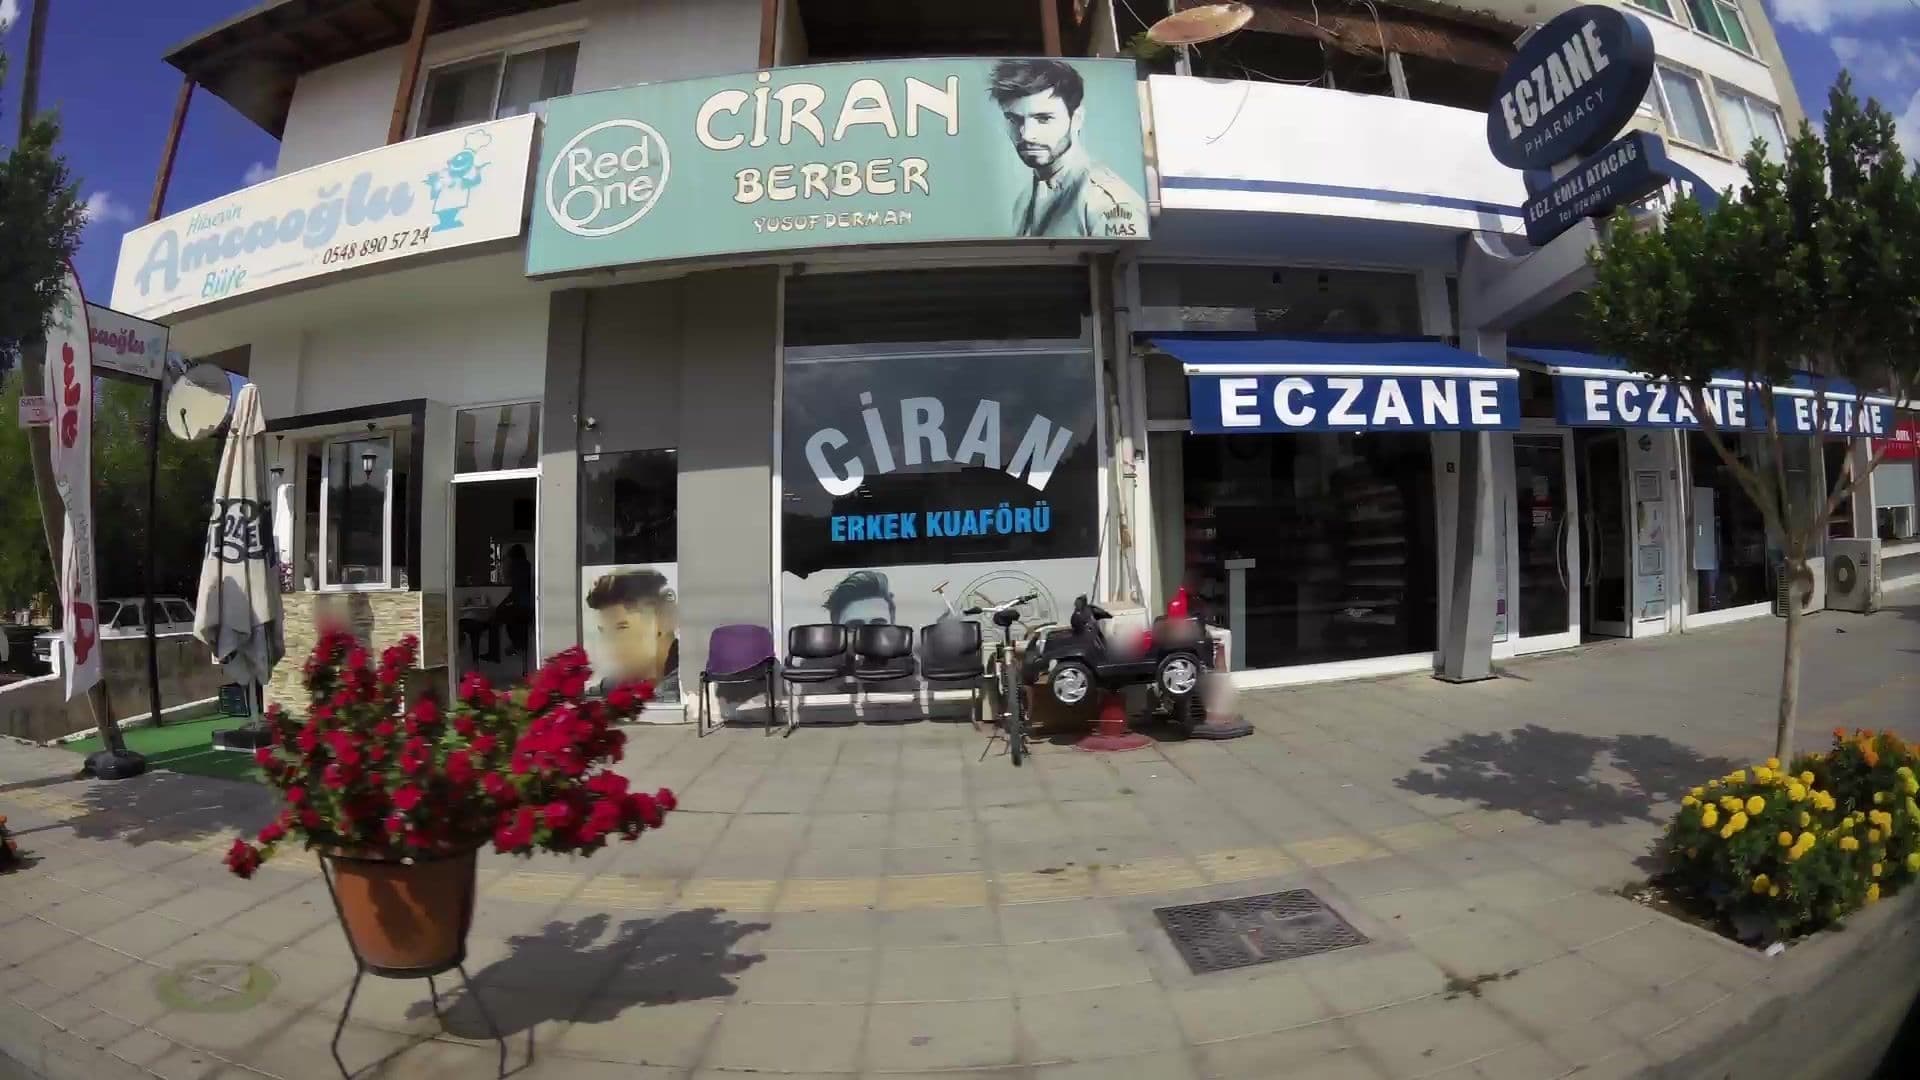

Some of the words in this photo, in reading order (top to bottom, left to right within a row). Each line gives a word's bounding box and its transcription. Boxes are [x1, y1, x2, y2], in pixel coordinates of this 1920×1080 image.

[1501, 20, 1609, 139] ECZANE
[695, 71, 959, 151] CİRAN
[1525, 87, 1604, 156] PHARMACY
[568, 135, 649, 187] Red
[734, 157, 930, 203] BERBER
[560, 175, 654, 226] One
[753, 215, 820, 233] YUSUF
[824, 210, 912, 229] DERMAN
[134, 172, 416, 297] Amcaoğlu
[322, 242, 356, 265] 0548
[360, 236, 387, 257] 890
[389, 230, 410, 250] 57
[410, 226, 430, 246] 24
[1105, 223, 1137, 237] MAS
[1219, 377, 1502, 427] ECZANE
[1584, 379, 1746, 426] ECZANE
[805, 391, 1074, 496] CİRAN
[831, 512, 918, 542] ERKEK
[926, 500, 1051, 537] KUAFÖRÜ
